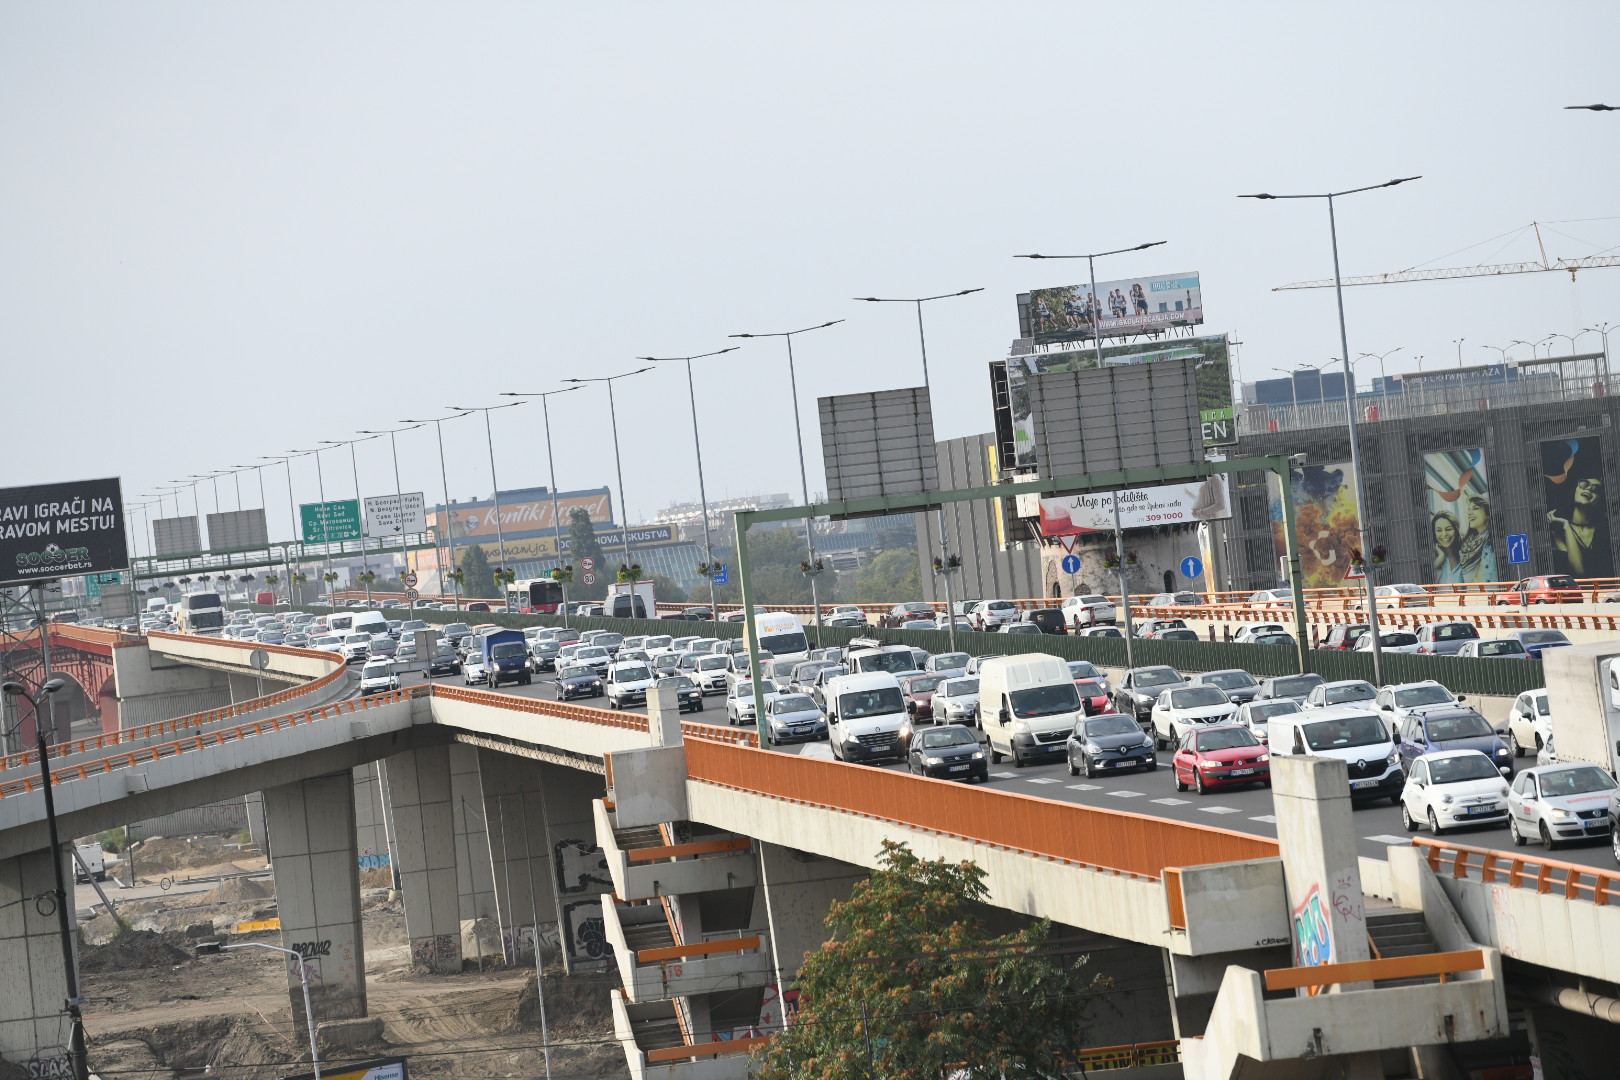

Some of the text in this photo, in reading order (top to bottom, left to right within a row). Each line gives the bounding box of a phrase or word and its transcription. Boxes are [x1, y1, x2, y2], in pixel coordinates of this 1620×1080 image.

[1205, 411, 1226, 420] ICA
[1201, 420, 1227, 440] EN
[1070, 492, 1149, 509] Moje poodilište
[0, 496, 114, 521] AVI IGRAČI NA
[1146, 514, 1161, 522] 309
[1163, 511, 1184, 520] 1000
[56, 514, 115, 535] MESTU!
[18, 561, 92, 575] www.soccerbet.rs
[584, 574, 594, 583] 80
[407, 591, 417, 599] 80
[374, 1072, 399, 1080] Hisense
